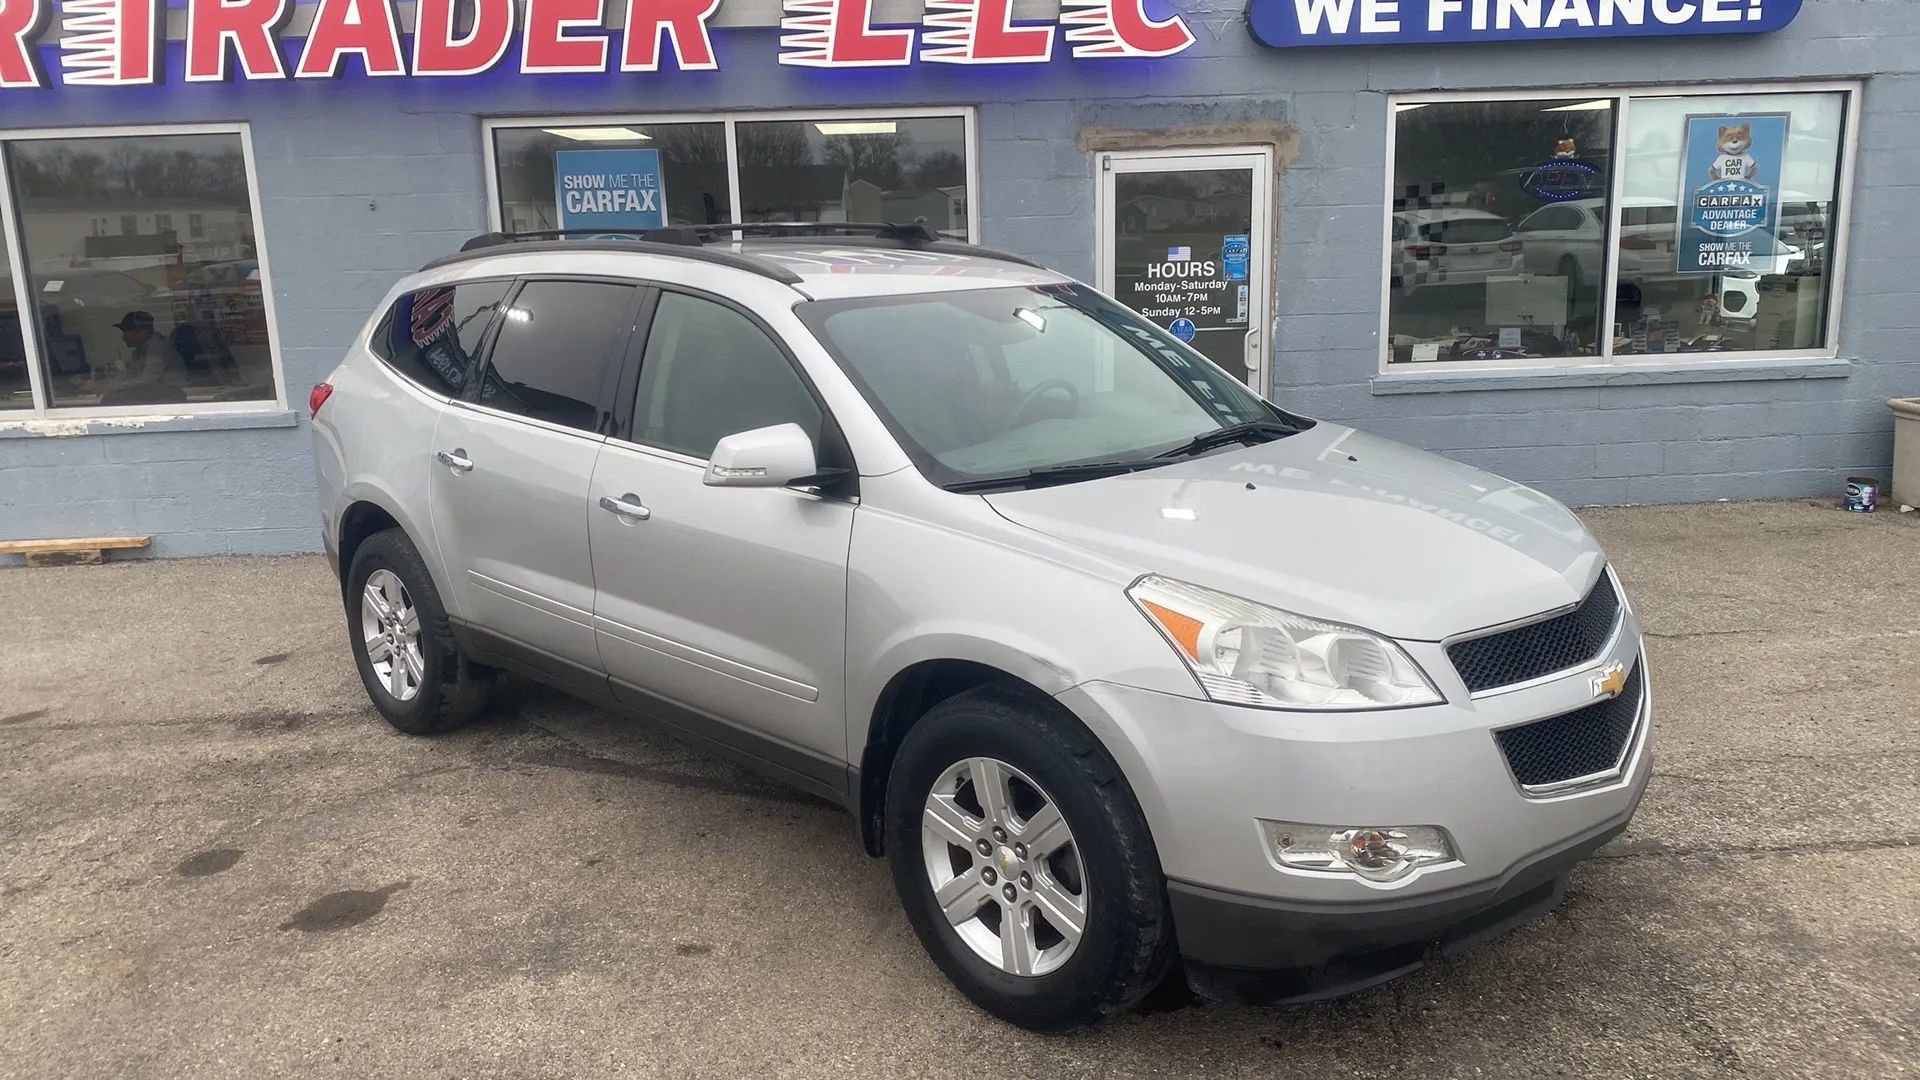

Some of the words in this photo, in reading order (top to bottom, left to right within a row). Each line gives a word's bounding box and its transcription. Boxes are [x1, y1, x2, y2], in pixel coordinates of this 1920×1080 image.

[1294, 0, 1400, 34] WE
[1426, 0, 1762, 33] FINANCE!
[779, 0, 1197, 67] LLC
[1725, 159, 1742, 168] CAR
[1725, 167, 1741, 176] FOX
[564, 174, 605, 189] SHOW
[609, 174, 629, 188] ME
[630, 173, 655, 187] THE
[566, 190, 657, 213] CARFAX
[1699, 195, 1762, 207] CARFAX
[1702, 209, 1757, 220] ADVANTAGE
[1710, 221, 1746, 230] DEALER
[1699, 243, 1725, 252] SHOW
[1725, 242, 1737, 251] ME
[1738, 242, 1752, 250] THE
[1698, 252, 1751, 266] CARFAX
[1148, 261, 1215, 278] HOURS
[1135, 280, 1228, 292] Monday-Saturday
[1142, 308, 1181, 318] Sunday
